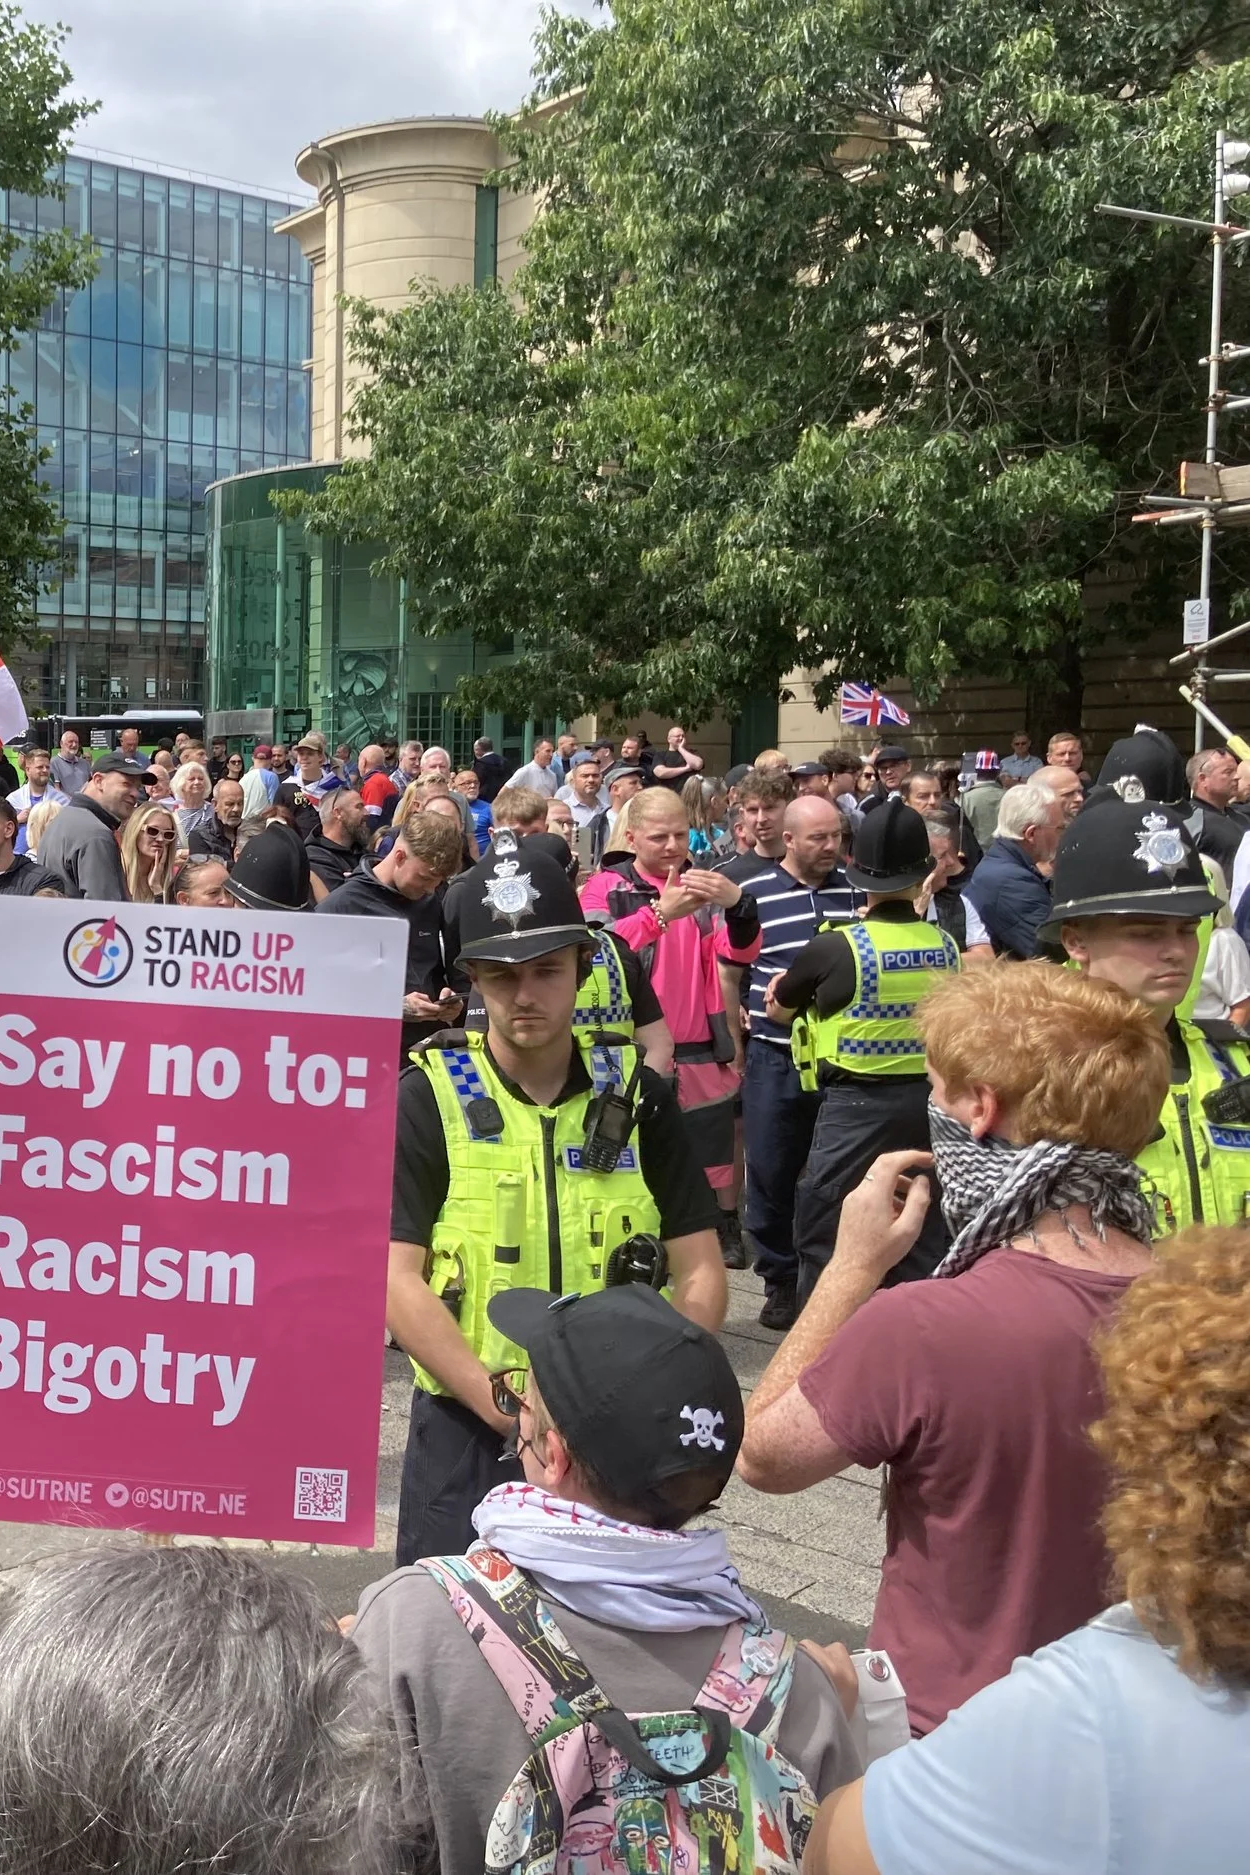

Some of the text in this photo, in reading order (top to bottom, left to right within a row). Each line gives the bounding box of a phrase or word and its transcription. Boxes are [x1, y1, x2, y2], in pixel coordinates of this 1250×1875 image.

[144, 925, 294, 962] STAND UP
[884, 950, 945, 969] POLICE
[143, 957, 305, 997] TO RACISM
[467, 1007, 486, 1016] POLICE
[148, 1042, 241, 1100] no
[264, 1035, 369, 1109] to:
[131, 1486, 247, 1516] @SUTR_NE
